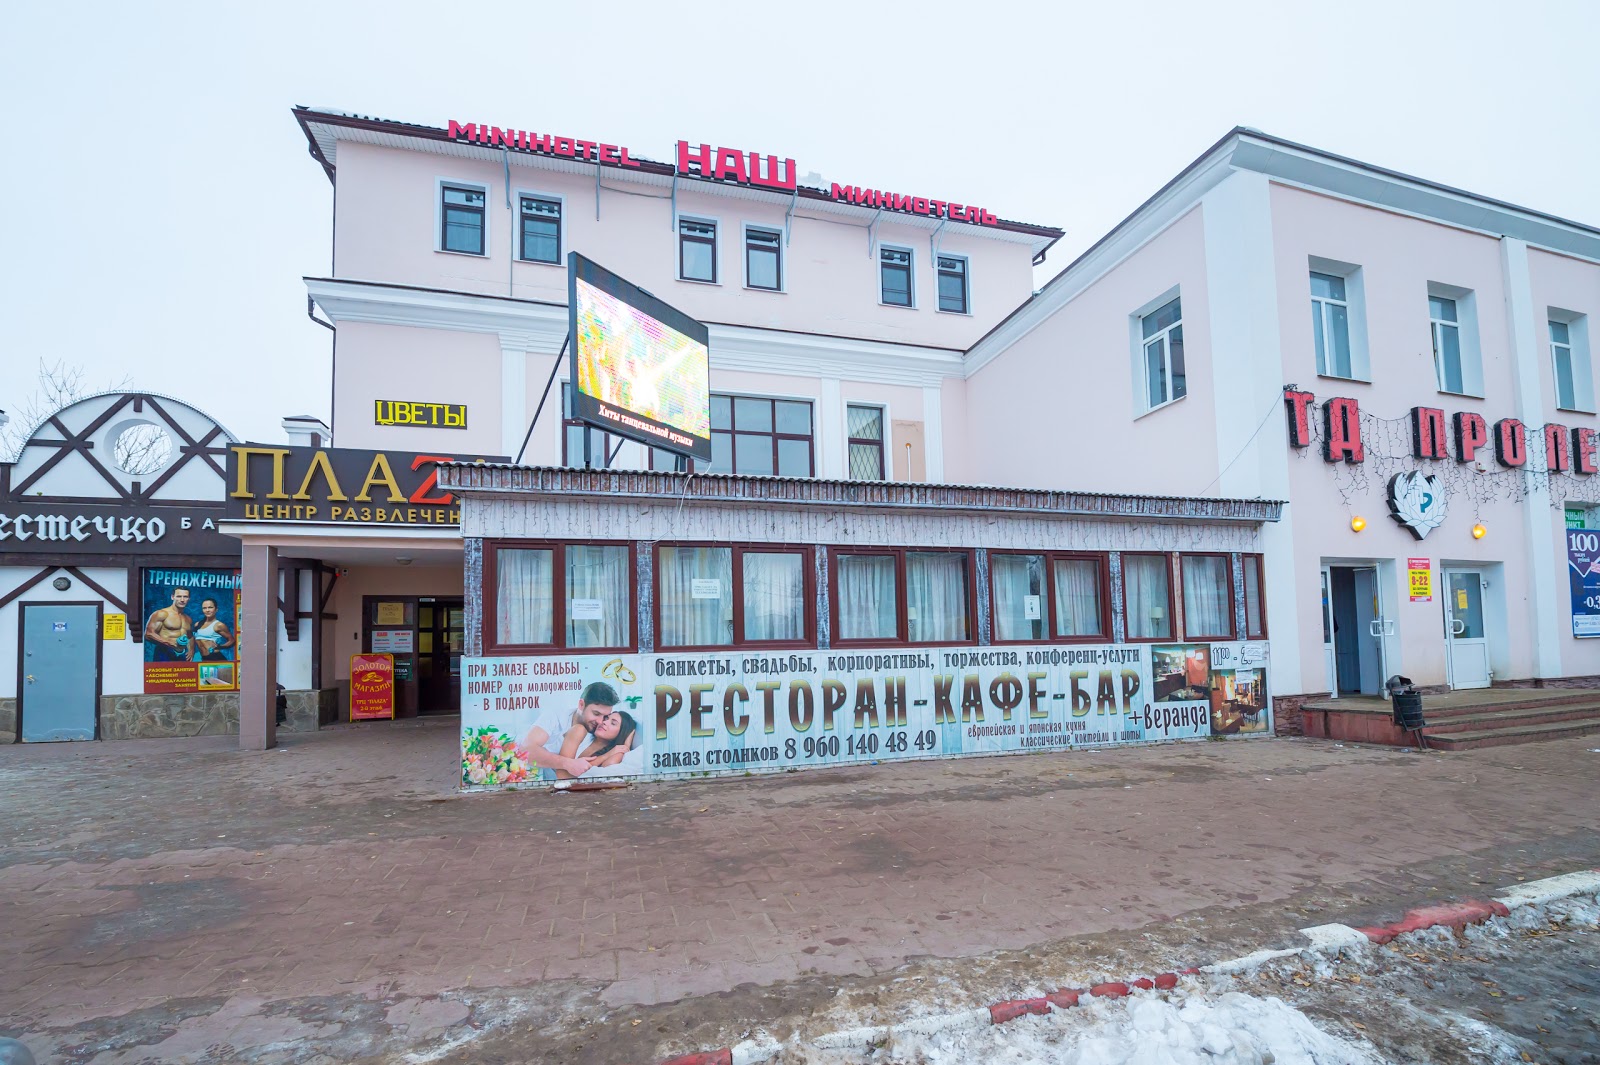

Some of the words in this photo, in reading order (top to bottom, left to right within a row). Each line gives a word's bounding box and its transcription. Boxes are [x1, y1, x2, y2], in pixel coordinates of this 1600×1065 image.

[448, 119, 640, 167] MINIHOTEL
[678, 140, 796, 191] НАШ
[831, 182, 997, 225] МИНИОТЕЛЬ
[375, 400, 466, 427] ЦВЕТЫ
[598, 404, 621, 421] Хиты
[621, 414, 669, 439] танцевальной
[669, 431, 693, 447] музыки
[1410, 406, 1600, 475] ПРОПЕ
[230, 446, 461, 505] ПЛАZ
[245, 503, 317, 520] ЦЕНТР
[331, 506, 461, 524] РАЗВЛЕЧЕН
[1569, 533, 1599, 552] 100
[148, 569, 242, 590] ТРЕНАЖЁРНЫЙ
[1411, 575, 1428, 586] 8-22
[354, 662, 390, 674] ЗОЛОТОЙ
[468, 664, 487, 677] ПРИ
[492, 663, 528, 677] ЗАКАЗЕ
[533, 661, 580, 676] СВАДЬБЫ
[655, 657, 736, 677] банкеты,
[741, 654, 817, 674] свадьбы,
[827, 653, 935, 673] корпоративы,
[943, 650, 1022, 670] торжества,
[1026, 648, 1140, 667] конференц-услуги
[354, 681, 391, 692] МАГАЗИН
[468, 680, 503, 694] НОМЕР
[508, 683, 523, 696] для
[527, 679, 582, 694] молодоженов
[495, 696, 540, 711] ПОДАРОК
[654, 669, 1140, 740] РЕСТОРАН-КАФЕ-БАР
[968, 723, 1016, 741] европейская
[1020, 723, 1025, 734] и
[1028, 721, 1062, 734] японская
[1065, 720, 1086, 736] кухня
[1020, 733, 1071, 748] классические
[1074, 730, 1109, 744] коктейли
[1112, 730, 1117, 741] и
[1120, 729, 1141, 741] шоты
[652, 749, 701, 768] заказ
[705, 746, 779, 765] столиков
[784, 738, 797, 759] 8
[803, 735, 840, 758] 960
[846, 733, 879, 756] 140
[884, 731, 908, 753] 48
[914, 729, 937, 751] 49
